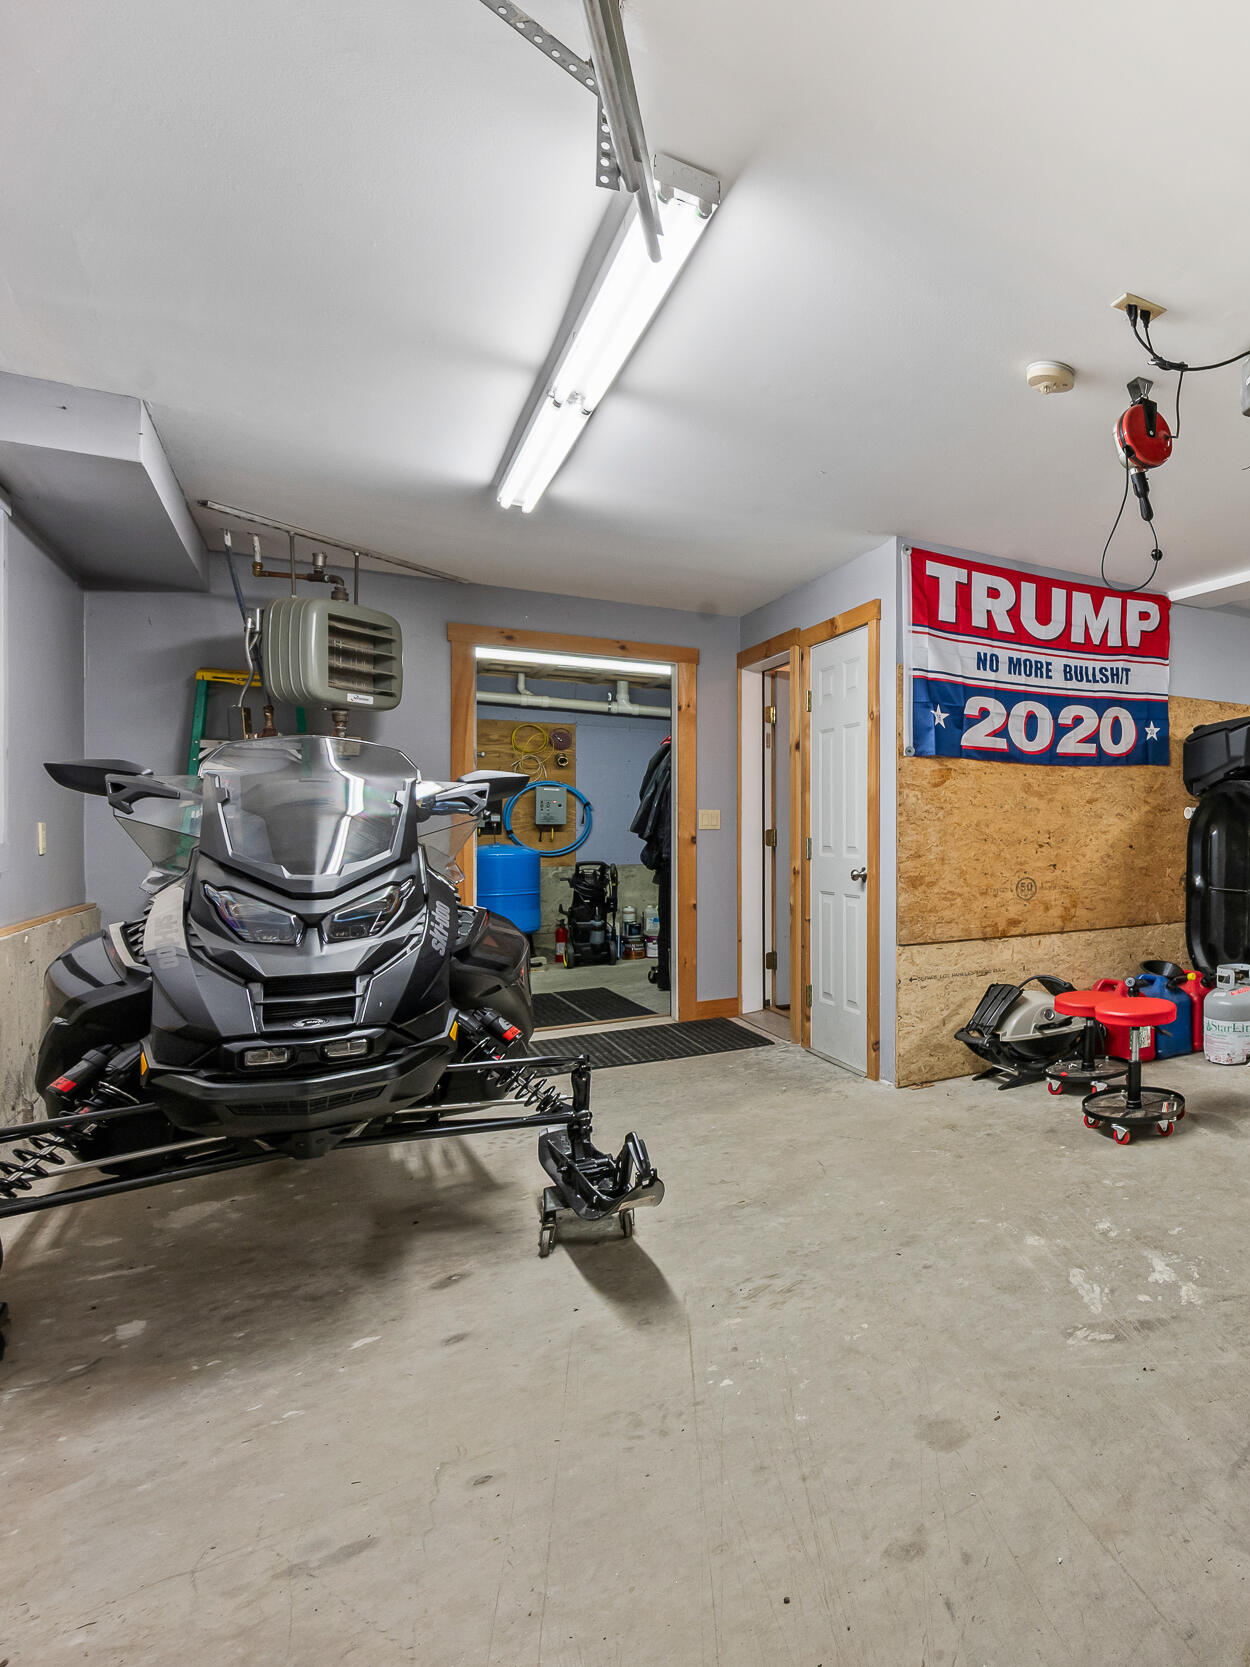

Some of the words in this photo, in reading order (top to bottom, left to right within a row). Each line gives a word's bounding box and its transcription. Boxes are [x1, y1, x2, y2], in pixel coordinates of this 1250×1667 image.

[925, 559, 1161, 649] TRUMP
[976, 651, 999, 673] NO
[1007, 656, 1053, 680] MORE
[1063, 663, 1131, 686] BULLSHIT
[960, 695, 1138, 758] 2020
[1020, 882, 1033, 893] 50
[429, 900, 451, 957] ski-doo
